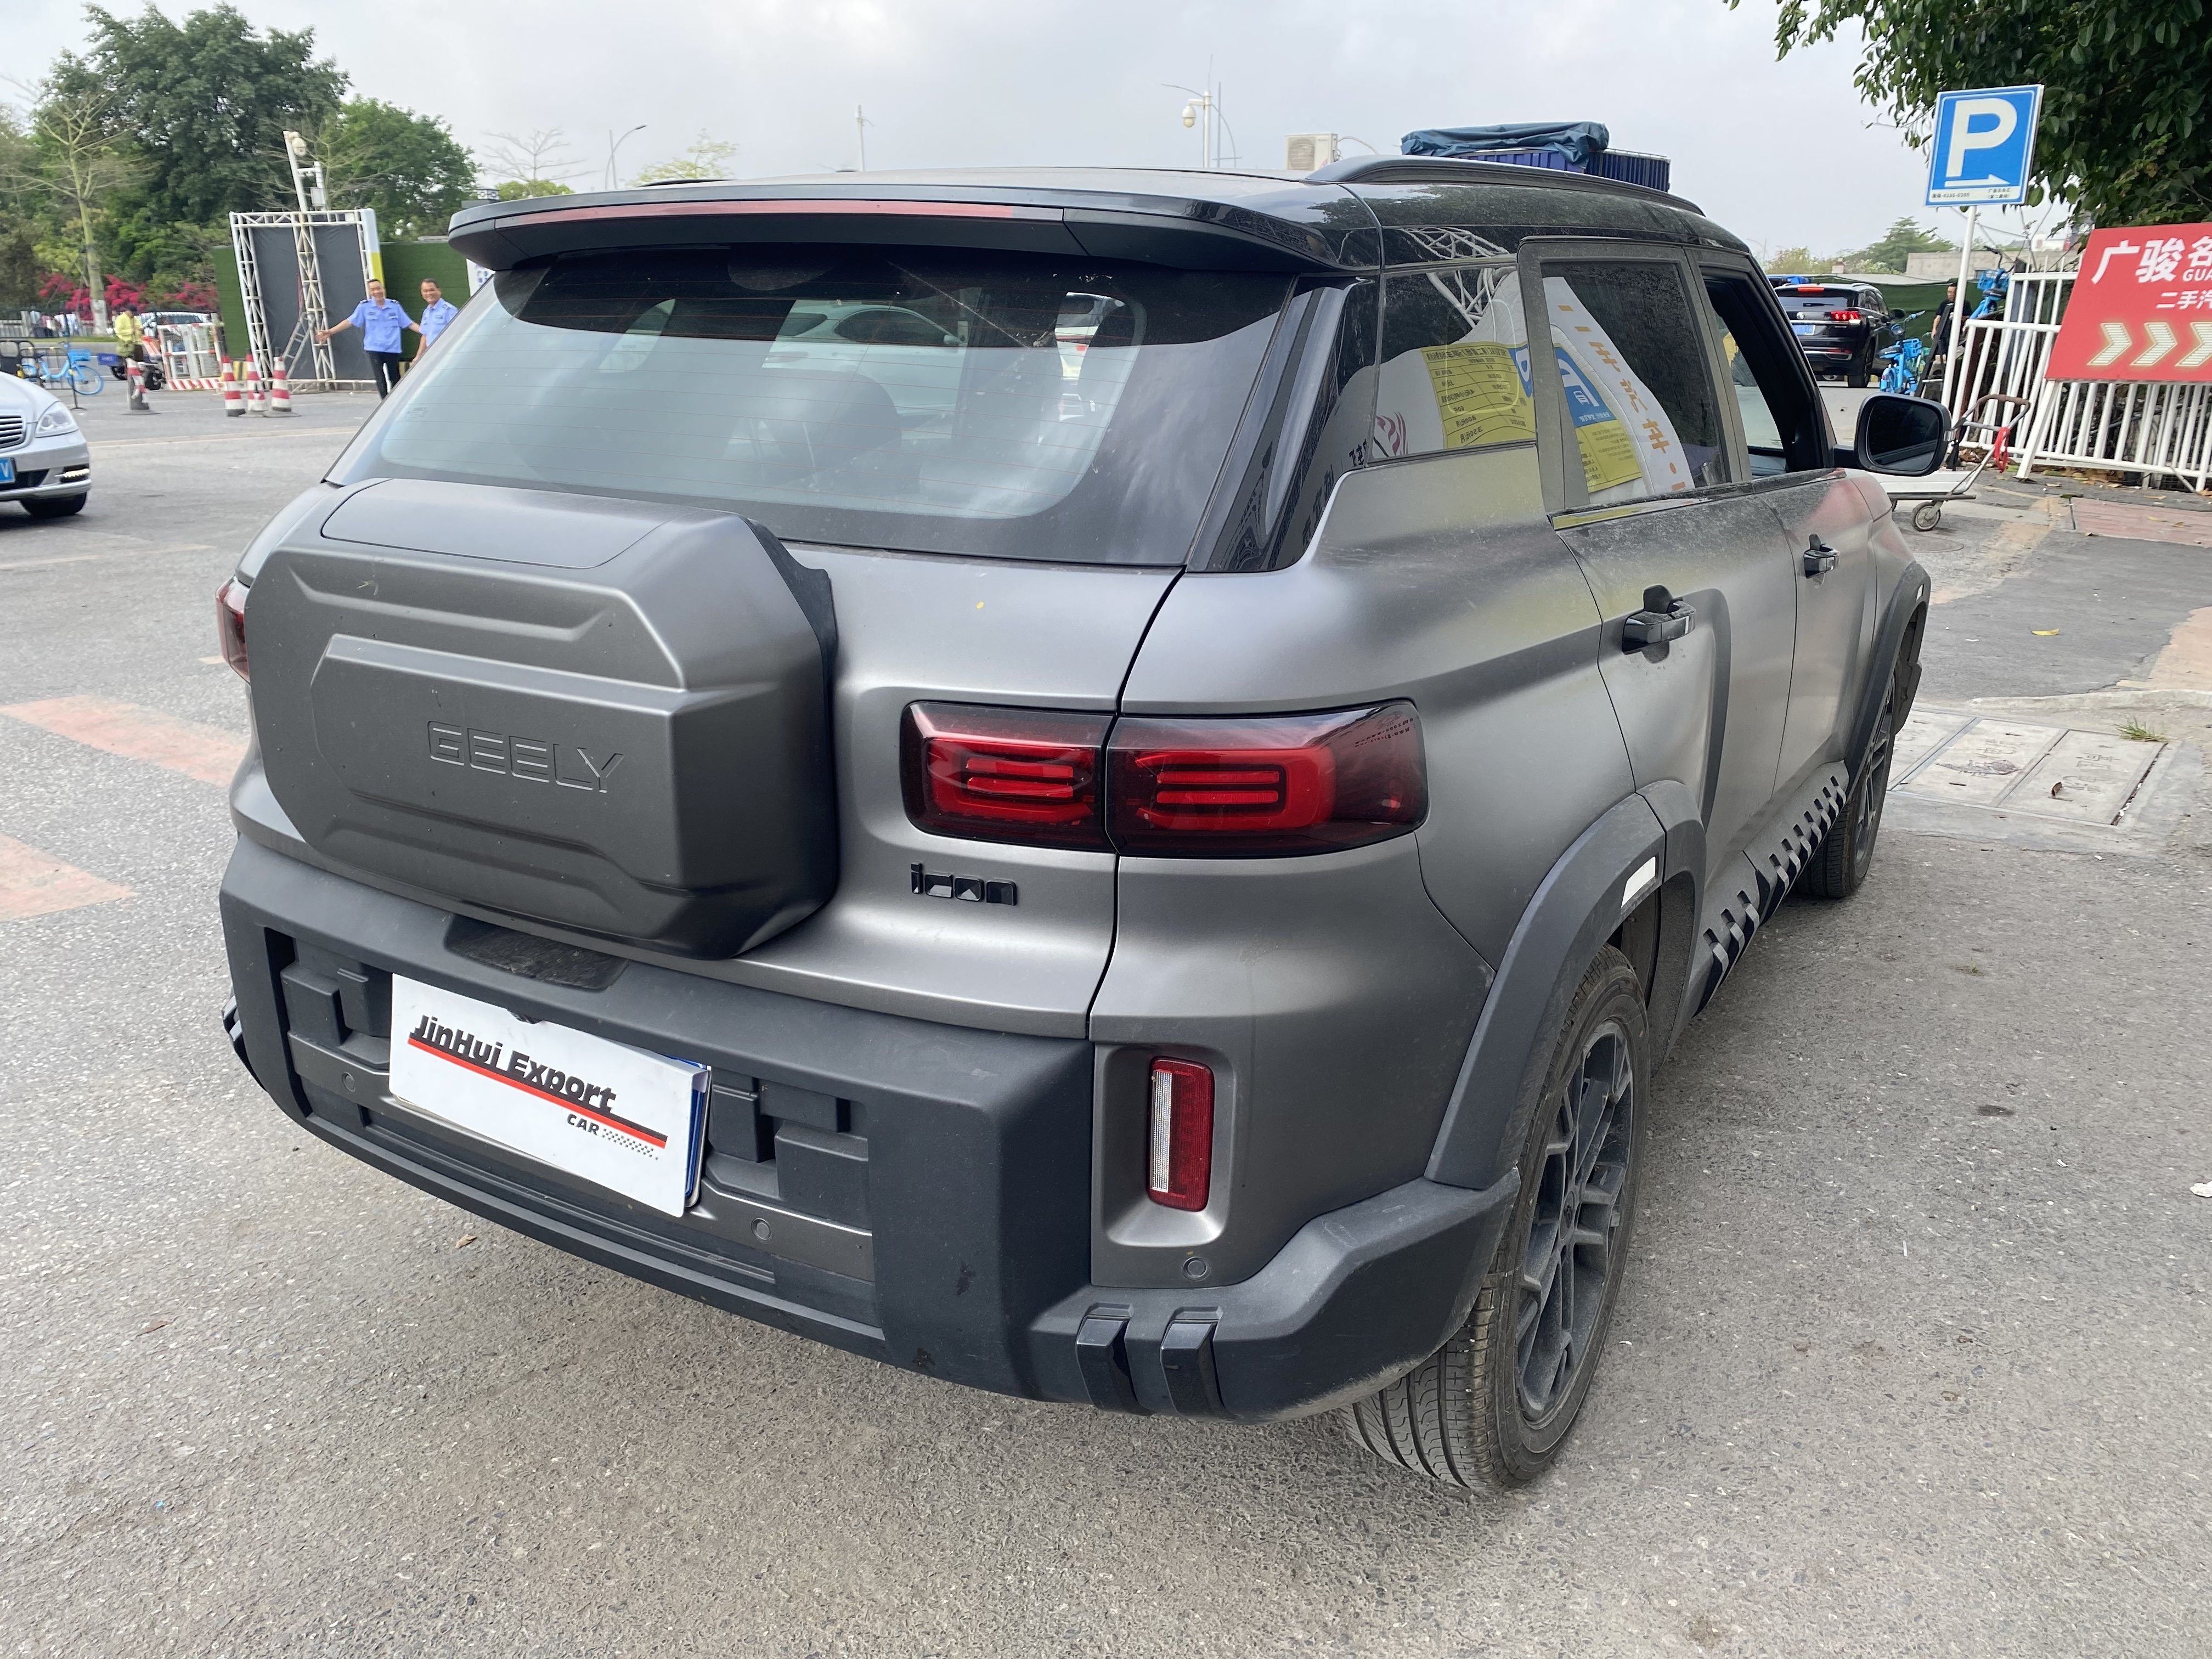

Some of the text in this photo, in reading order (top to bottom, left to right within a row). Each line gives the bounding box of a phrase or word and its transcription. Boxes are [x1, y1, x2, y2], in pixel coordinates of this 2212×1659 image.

[1946, 98, 2017, 177] P
[2091, 236, 2212, 284] 广骏名
[427, 721, 624, 793] GEELY
[411, 1014, 617, 1113] JinHui Export
[567, 1114, 600, 1136] CAR
